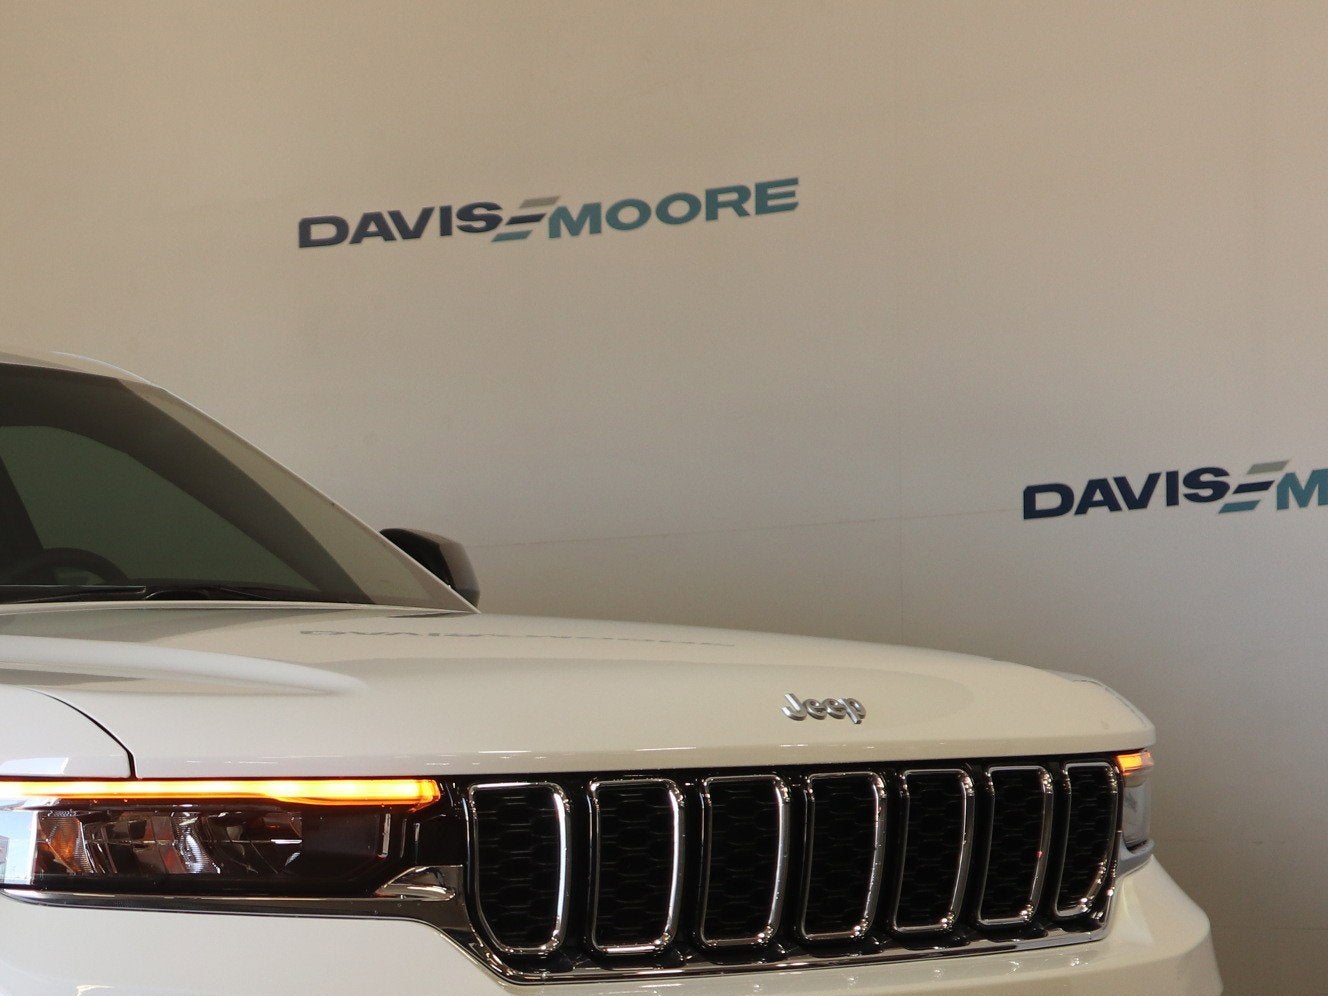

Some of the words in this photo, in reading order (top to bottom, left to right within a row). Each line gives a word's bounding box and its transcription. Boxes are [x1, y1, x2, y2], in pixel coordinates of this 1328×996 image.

[299, 201, 503, 248] DAVIS
[547, 177, 799, 239] MOORE
[1023, 467, 1230, 520] DAVIS
[780, 693, 866, 724] Jeep
